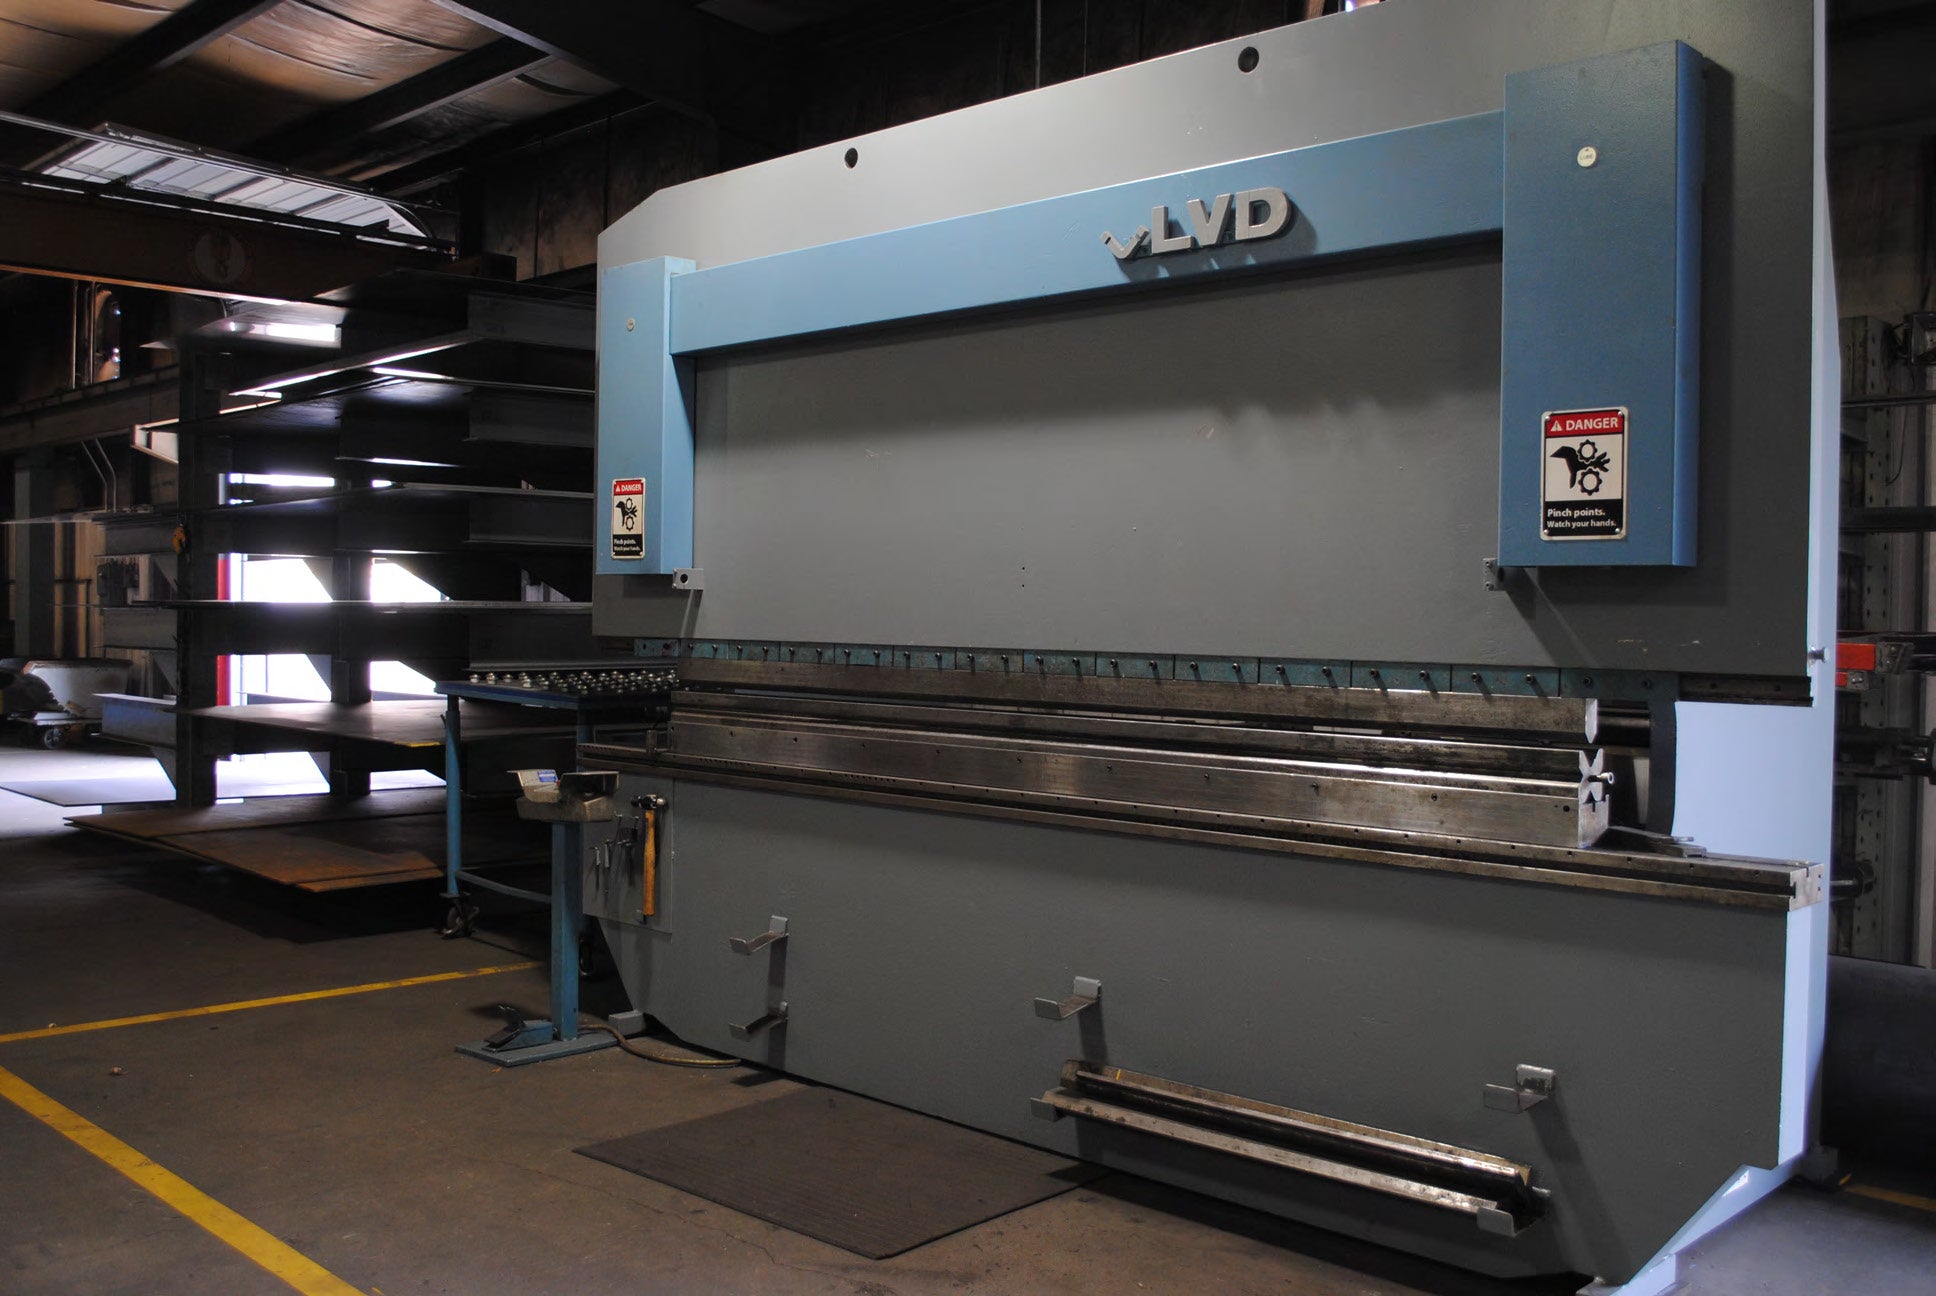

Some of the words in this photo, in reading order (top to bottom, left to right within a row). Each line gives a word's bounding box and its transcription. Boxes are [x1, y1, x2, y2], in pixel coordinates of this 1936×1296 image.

[1152, 187, 1291, 254] LVD
[1566, 417, 1619, 431] DANGER
[621, 483, 642, 492] DANGER
[1547, 508, 1572, 517] Pinch
[1573, 508, 1606, 519] points.
[1547, 520, 1571, 528] Watch
[1571, 521, 1590, 529] your
[1590, 519, 1617, 527] hands.
